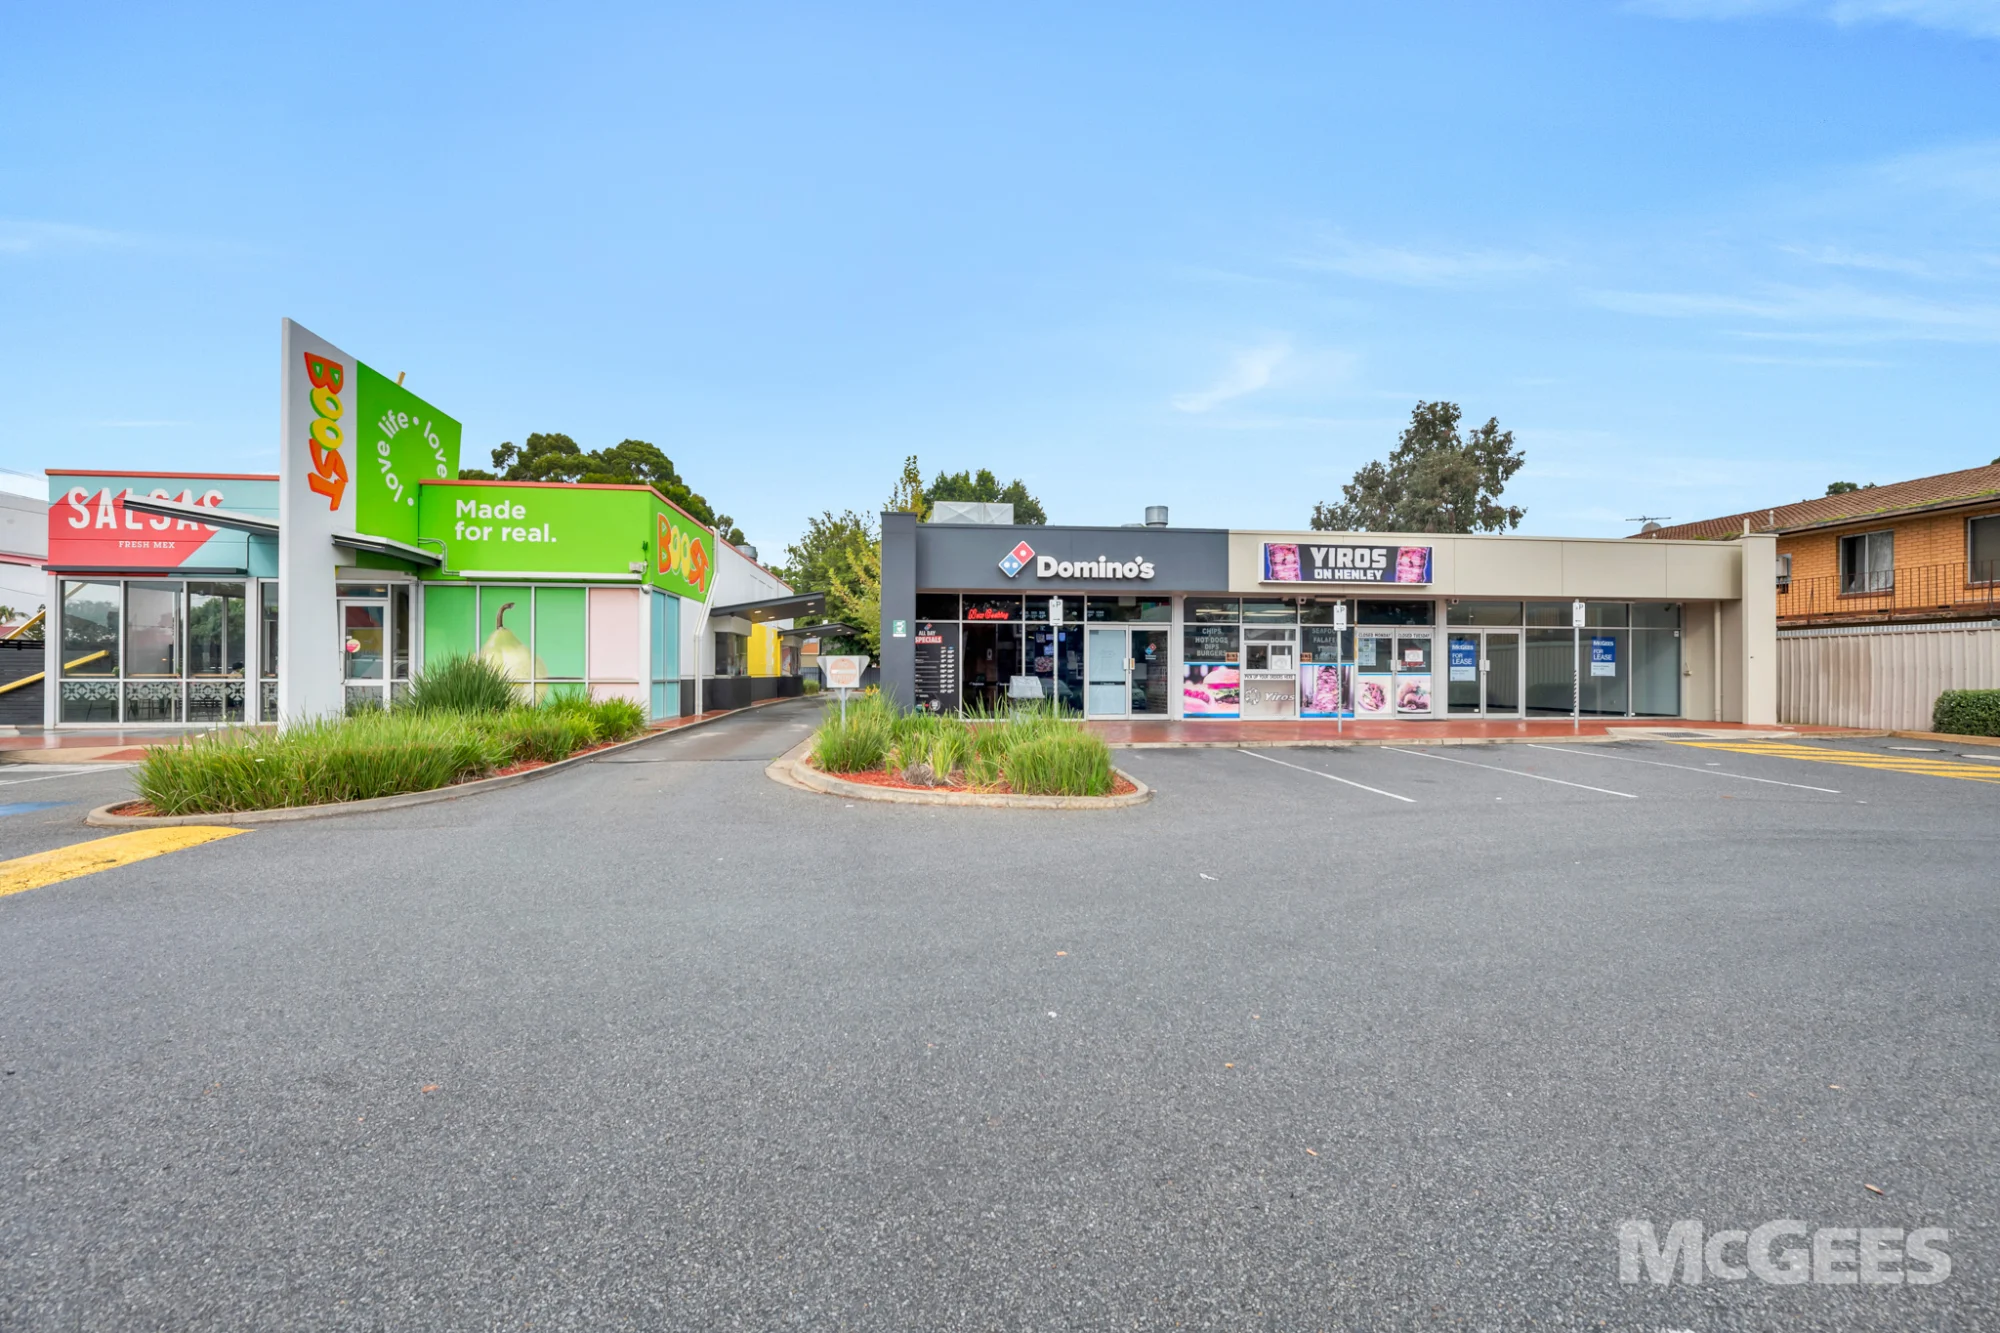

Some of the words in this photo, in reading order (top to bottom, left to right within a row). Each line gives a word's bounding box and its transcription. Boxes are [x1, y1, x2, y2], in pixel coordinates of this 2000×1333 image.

[304, 352, 348, 511] BOOST
[378, 410, 409, 439] life
[456, 499, 526, 519] Made
[455, 521, 492, 541] for
[501, 523, 557, 543] real.
[657, 513, 710, 593] BOOST
[1310, 547, 1387, 569] YIROS
[1037, 555, 1156, 579] Domino's
[1314, 568, 1332, 579] ON
[1334, 568, 1383, 581] HENLEY
[915, 636, 942, 644] SPECIALS
[1264, 691, 1295, 701] Yiros
